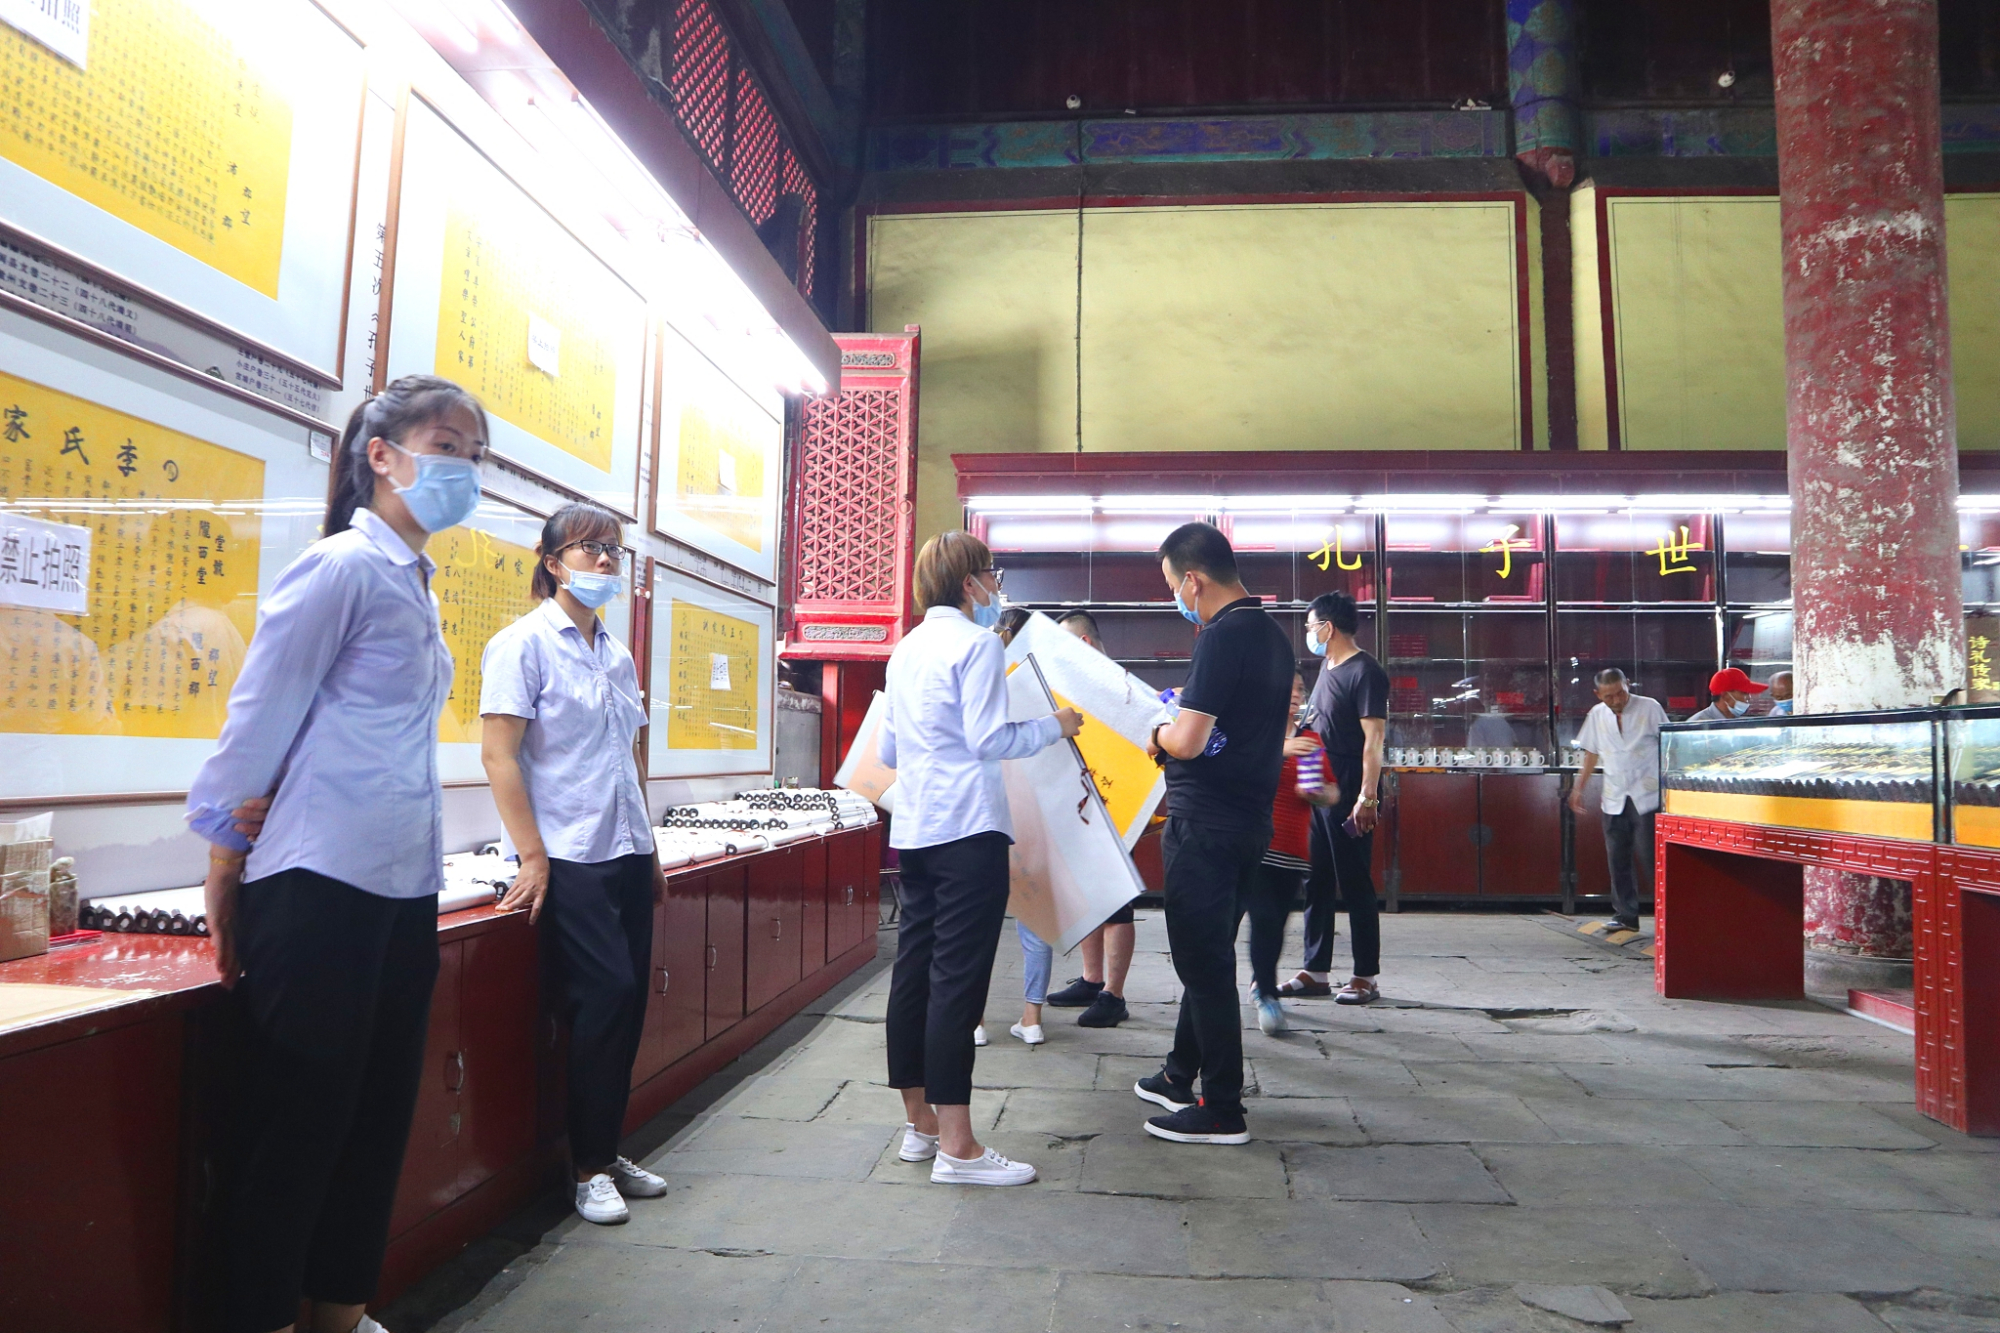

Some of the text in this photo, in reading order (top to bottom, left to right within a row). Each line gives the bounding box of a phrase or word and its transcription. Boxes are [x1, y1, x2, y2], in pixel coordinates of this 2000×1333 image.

[0, 530, 82, 593] 禁止拍照
[1967, 635, 1992, 691] 诗礼传家
